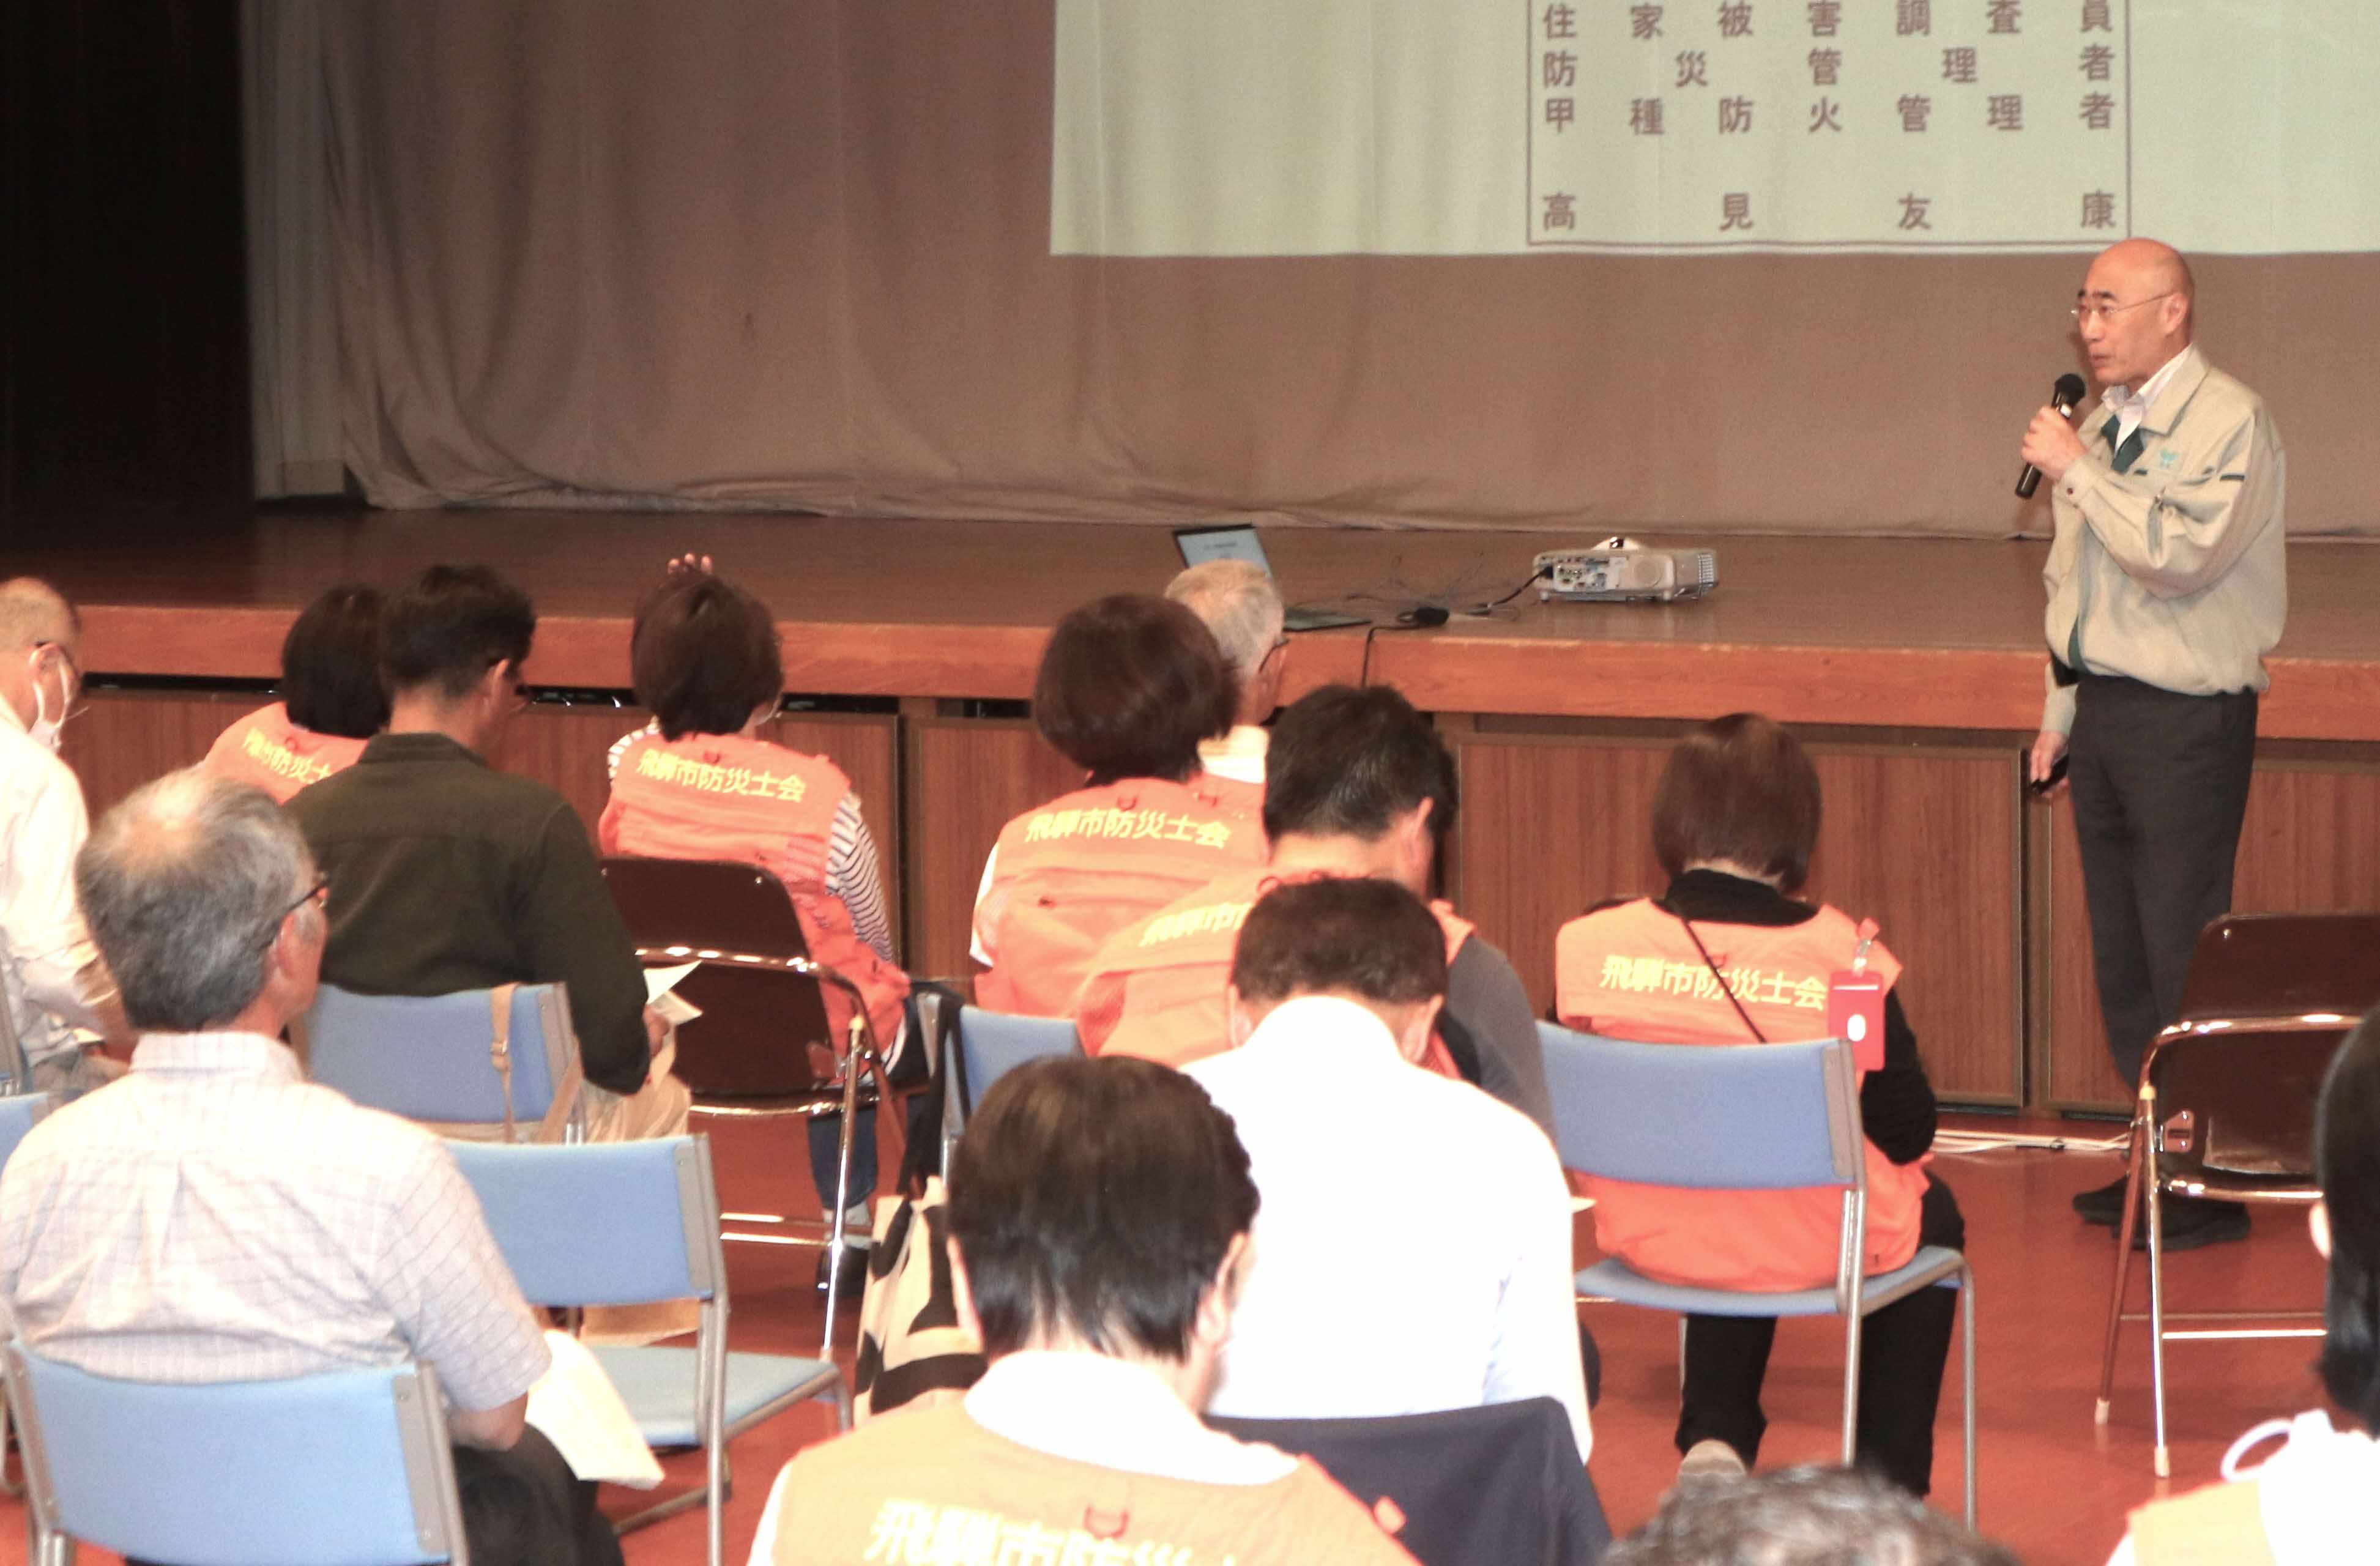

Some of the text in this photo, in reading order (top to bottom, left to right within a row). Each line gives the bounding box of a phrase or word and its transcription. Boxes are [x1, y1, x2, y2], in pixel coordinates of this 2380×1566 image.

[1542, 0, 2113, 40] 住家被害調査員
[1542, 43, 2115, 89] 防災管理者
[1545, 91, 2115, 136] 甲種防火管理者
[1542, 189, 2116, 231] 高見友康
